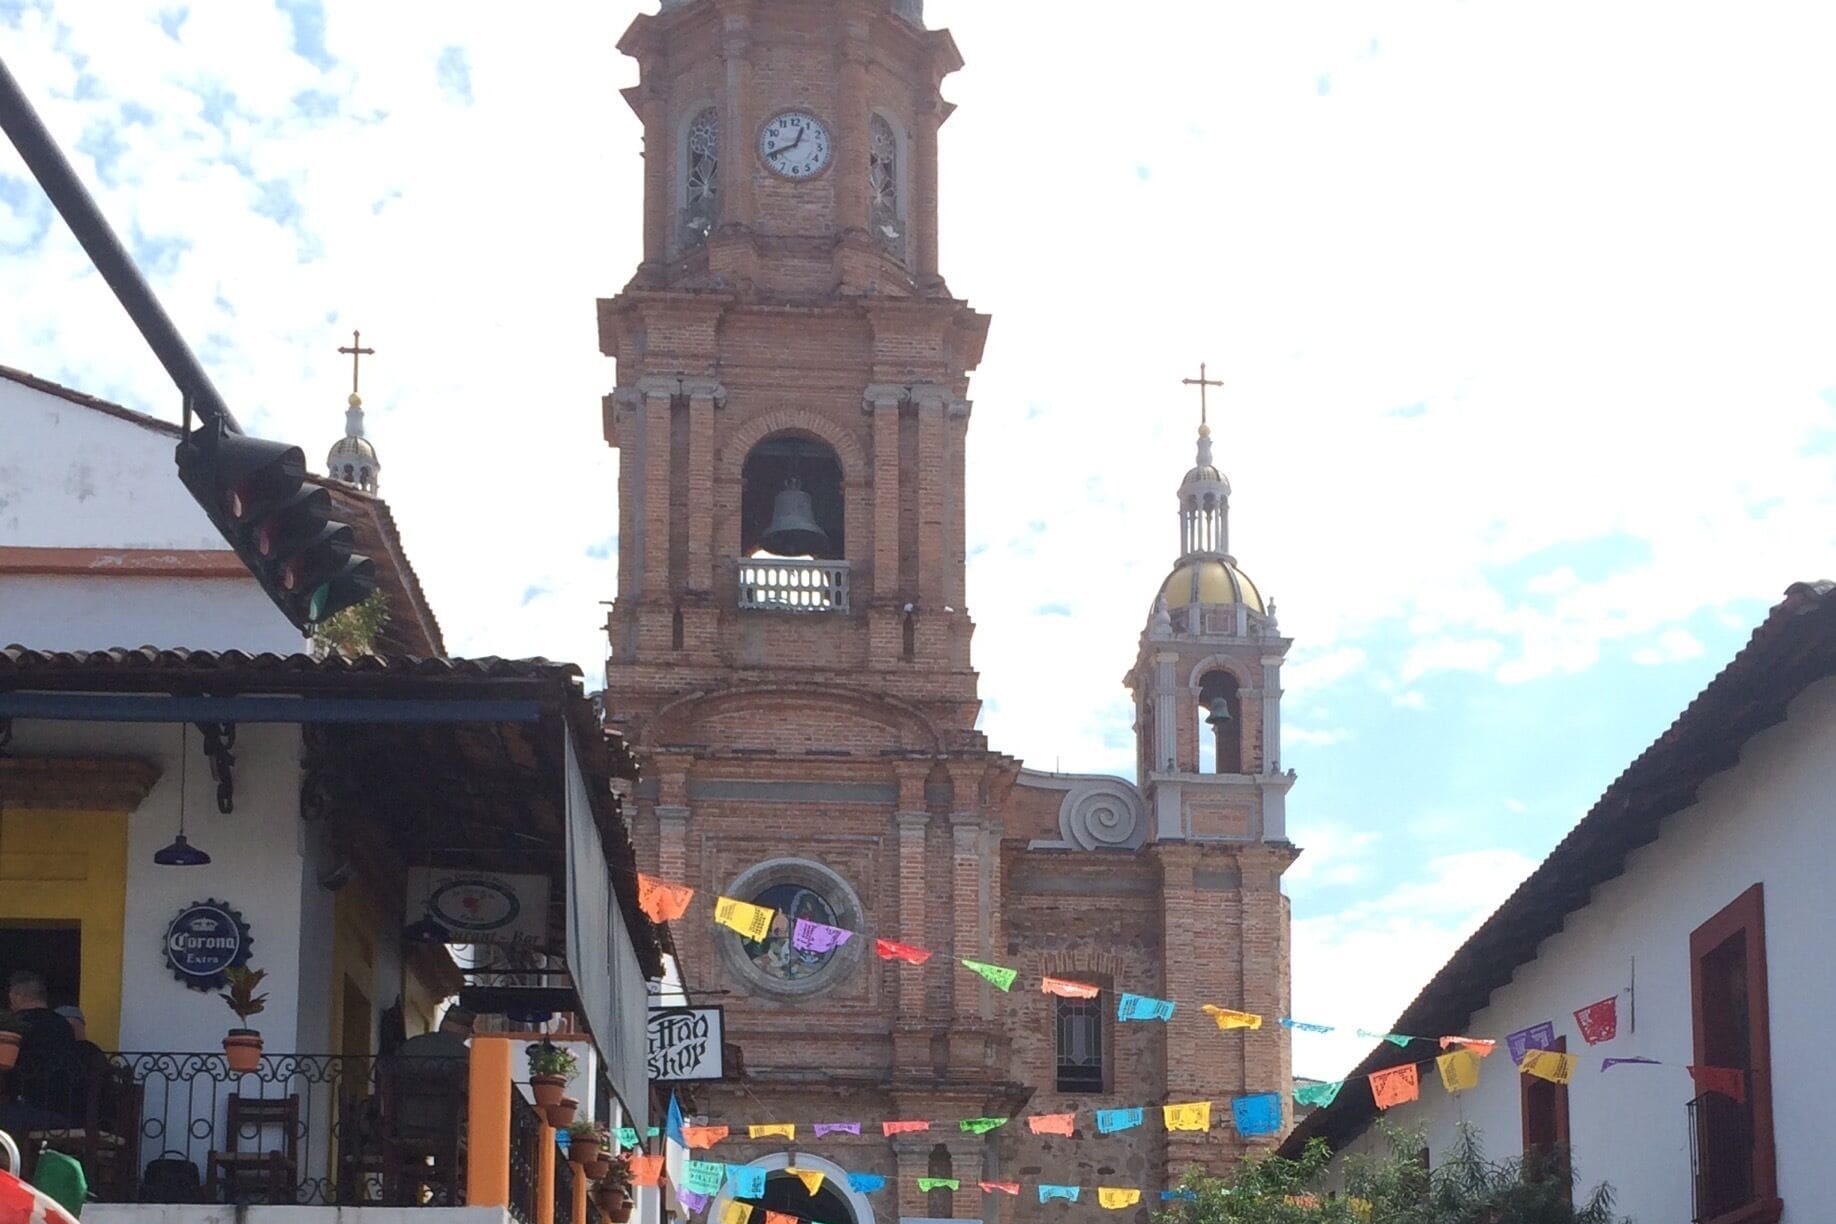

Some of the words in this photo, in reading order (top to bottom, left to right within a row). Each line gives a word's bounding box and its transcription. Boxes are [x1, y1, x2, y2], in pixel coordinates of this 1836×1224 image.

[779, 120, 788, 128] 11
[790, 118, 800, 126] 12
[806, 122, 811, 130] 1
[769, 129, 779, 137] 10
[814, 130, 822, 139] 2
[767, 140, 775, 149] 9
[816, 143, 824, 152] 3
[812, 154, 819, 162] 4
[780, 162, 786, 171] 7
[791, 165, 800, 174] 6
[804, 163, 811, 172] 5
[170, 932, 235, 951] Corona
[186, 953, 219, 964] Extra
